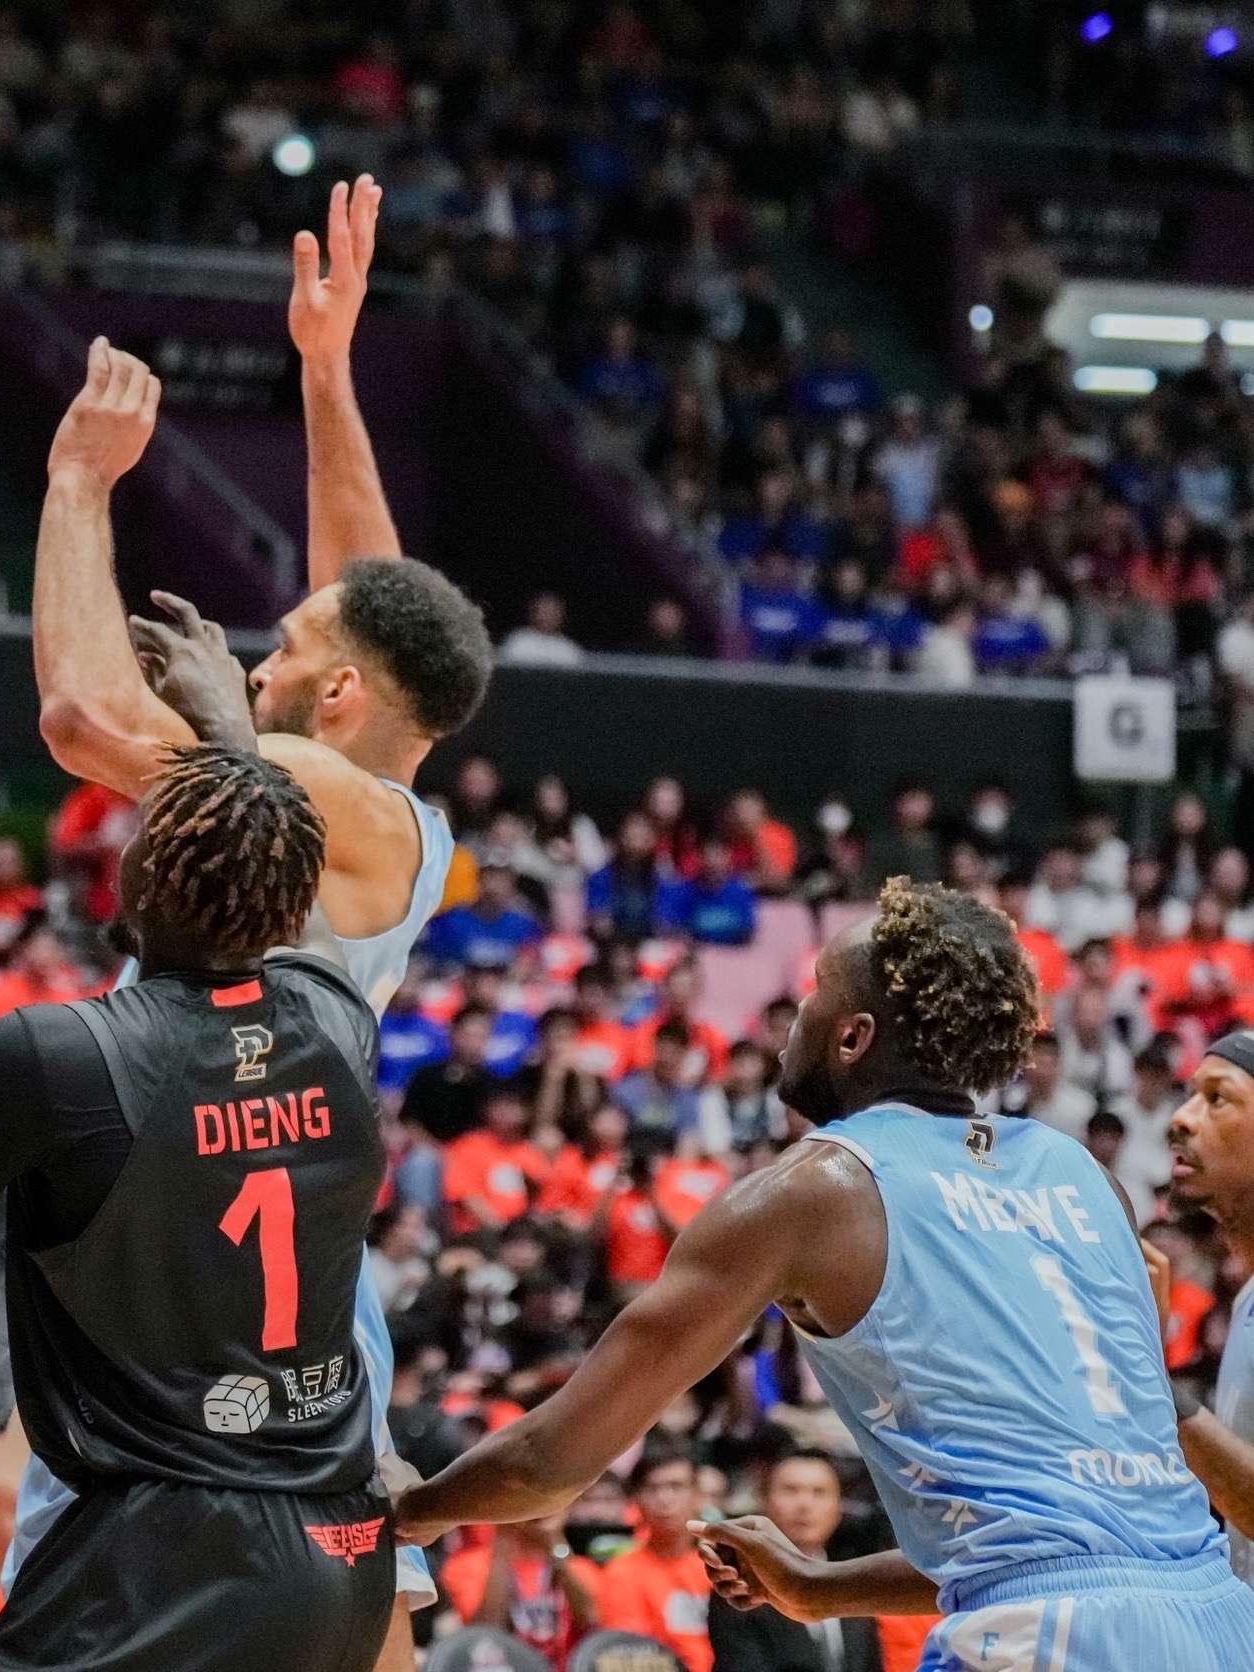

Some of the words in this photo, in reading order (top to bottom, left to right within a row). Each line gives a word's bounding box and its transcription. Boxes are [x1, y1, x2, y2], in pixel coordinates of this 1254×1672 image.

[1109, 701, 1144, 746] G
[193, 1087, 332, 1156] DIENG
[930, 1171, 1102, 1244] MBAYE
[218, 1167, 299, 1352] 1
[1030, 1252, 1127, 1416] 1
[287, 1402, 328, 1423] SLEEK
[980, 1631, 1000, 1661] F
